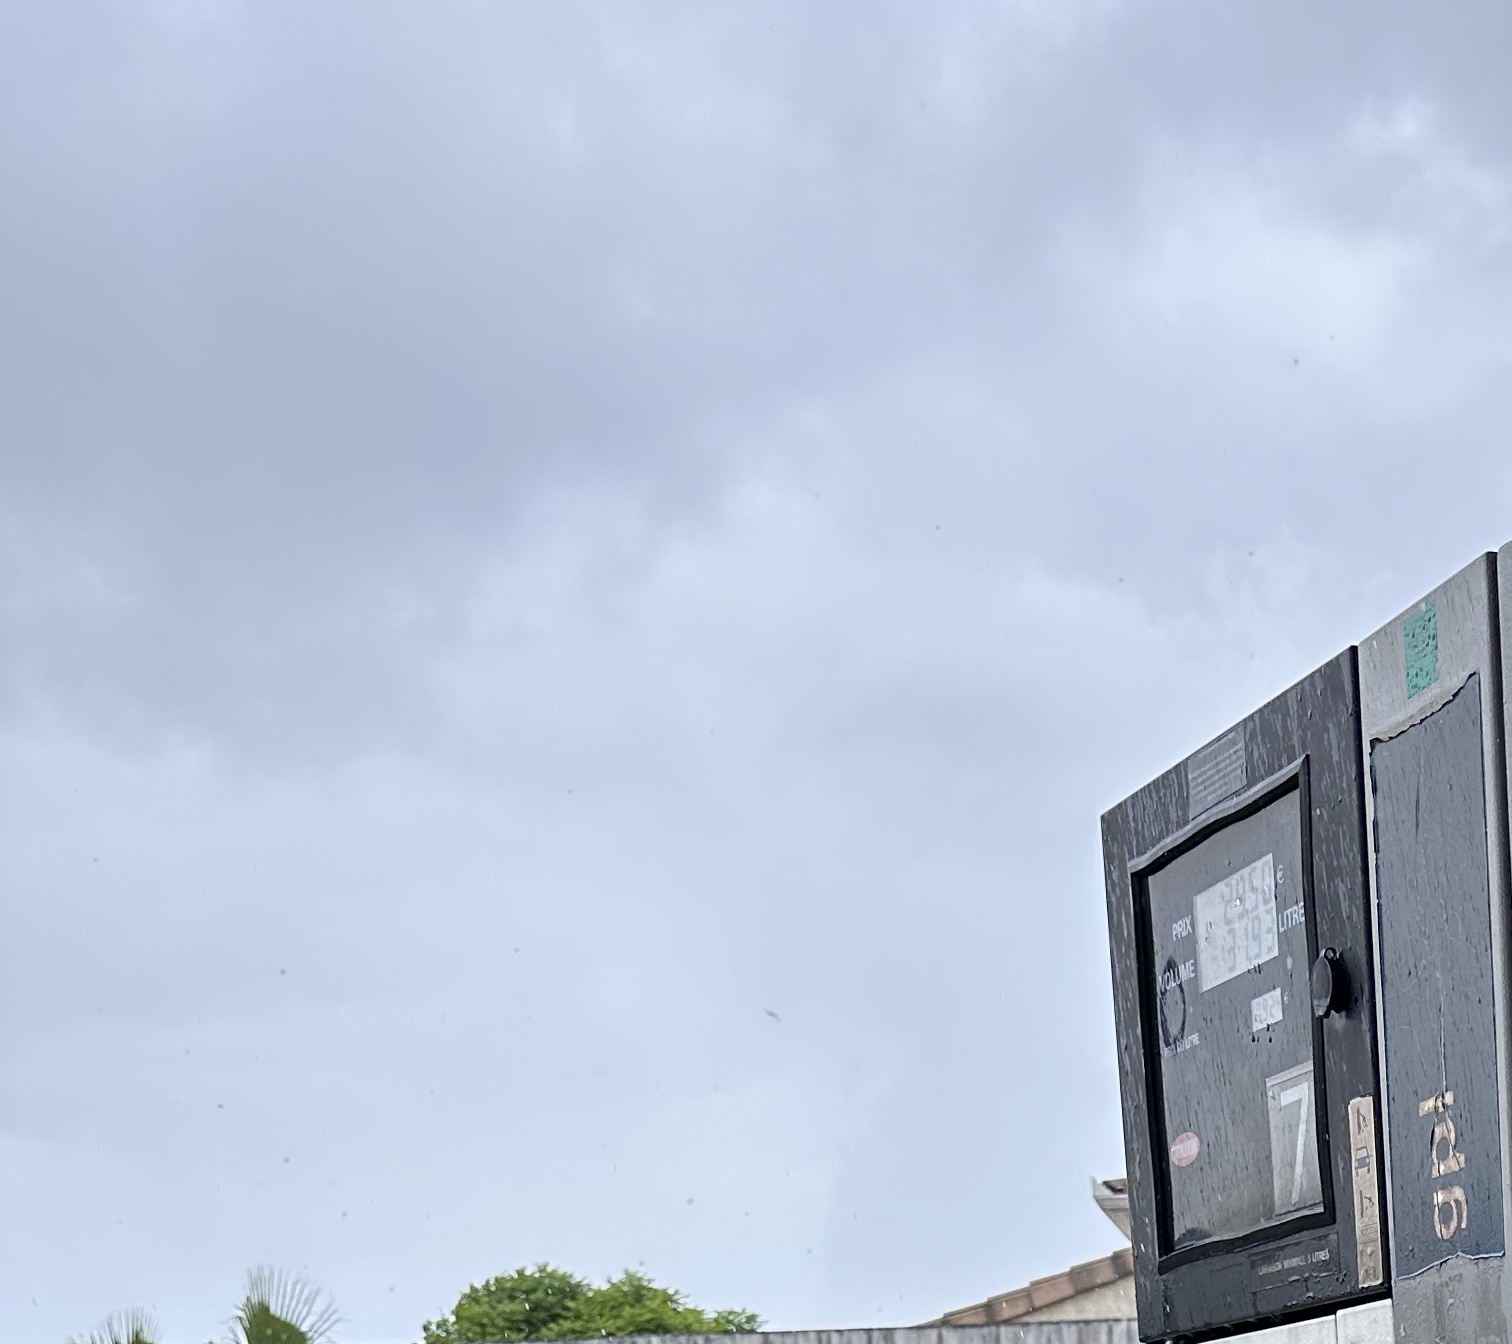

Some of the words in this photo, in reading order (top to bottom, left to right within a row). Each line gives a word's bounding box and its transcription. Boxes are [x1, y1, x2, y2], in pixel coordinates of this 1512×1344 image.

[1172, 915, 1193, 942] PRIX
[1159, 959, 1196, 993] VOLUME
[1280, 1081, 1309, 1206] 7
